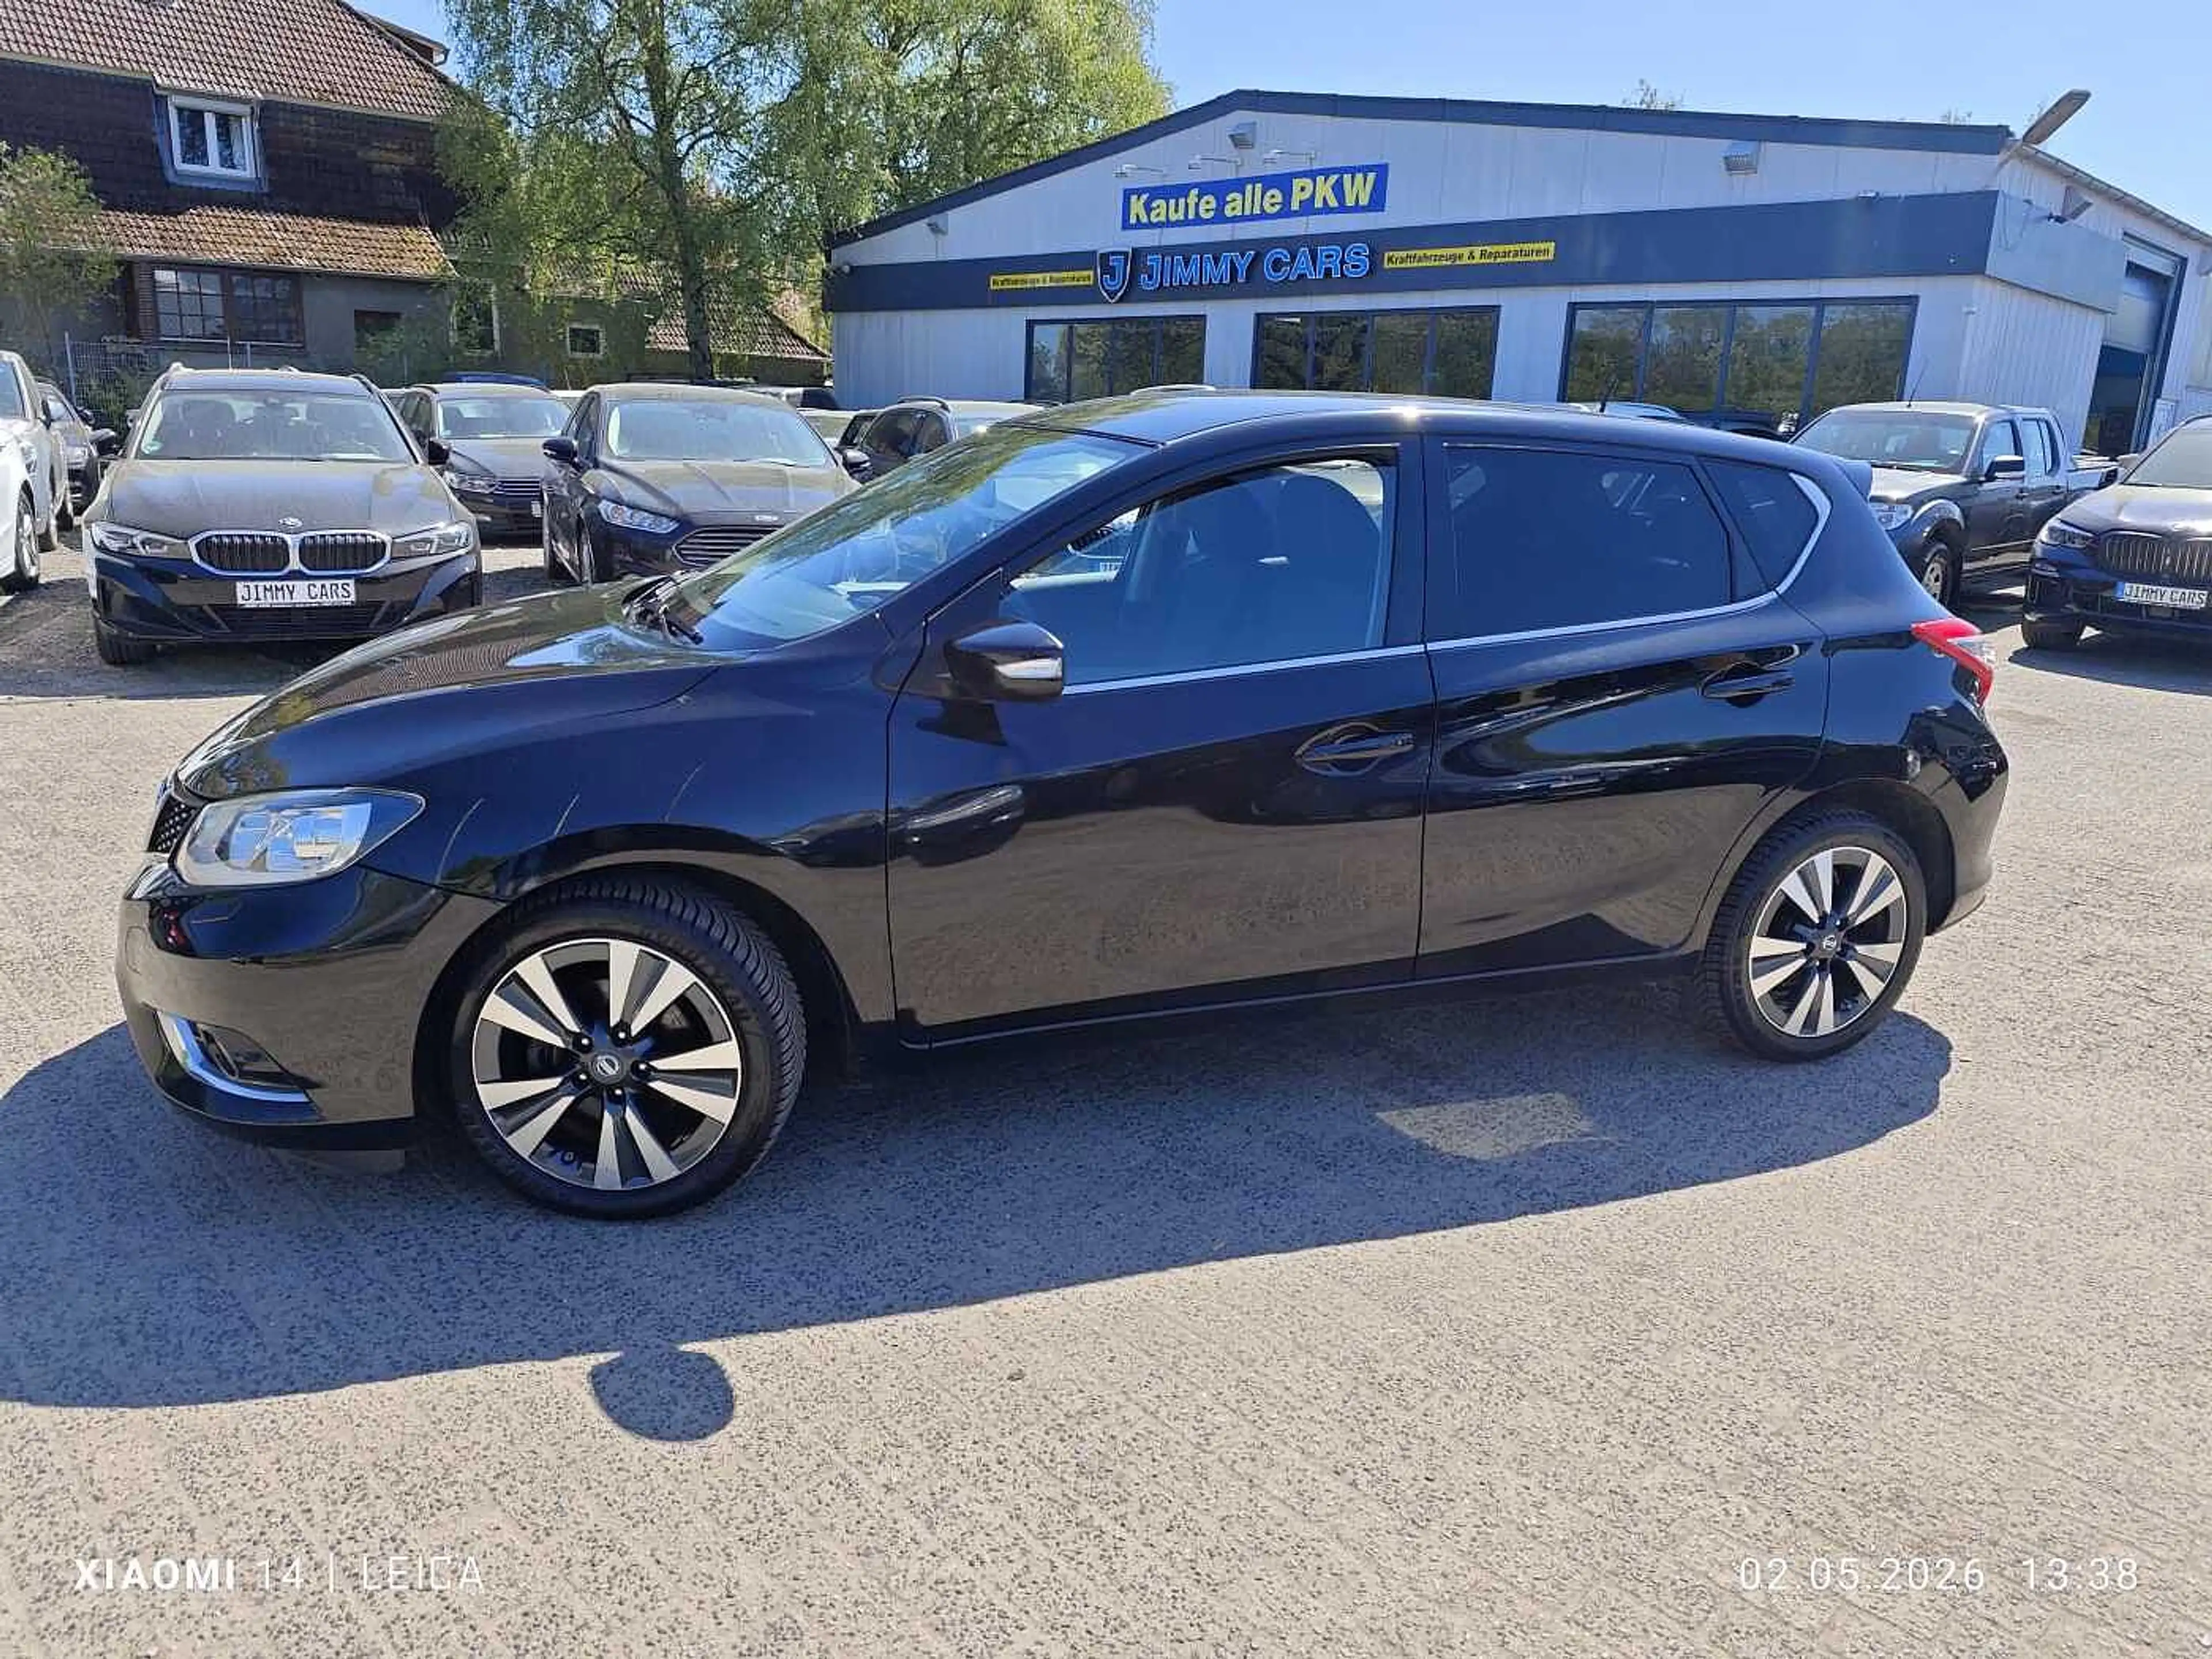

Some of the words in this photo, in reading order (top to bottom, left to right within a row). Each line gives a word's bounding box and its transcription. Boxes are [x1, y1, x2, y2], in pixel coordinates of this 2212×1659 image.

[1129, 188, 1217, 225] Kaufe
[1224, 183, 1283, 217] alle
[1290, 173, 1377, 211] PKW
[1480, 247, 1551, 260] Reparaturen
[1140, 251, 1256, 290] JIMMY
[1264, 243, 1370, 282] CARS
[241, 584, 295, 601] JIMMY
[307, 583, 351, 599] CARS
[2124, 584, 2168, 601] JIMMY
[2171, 588, 2205, 605] CARS
